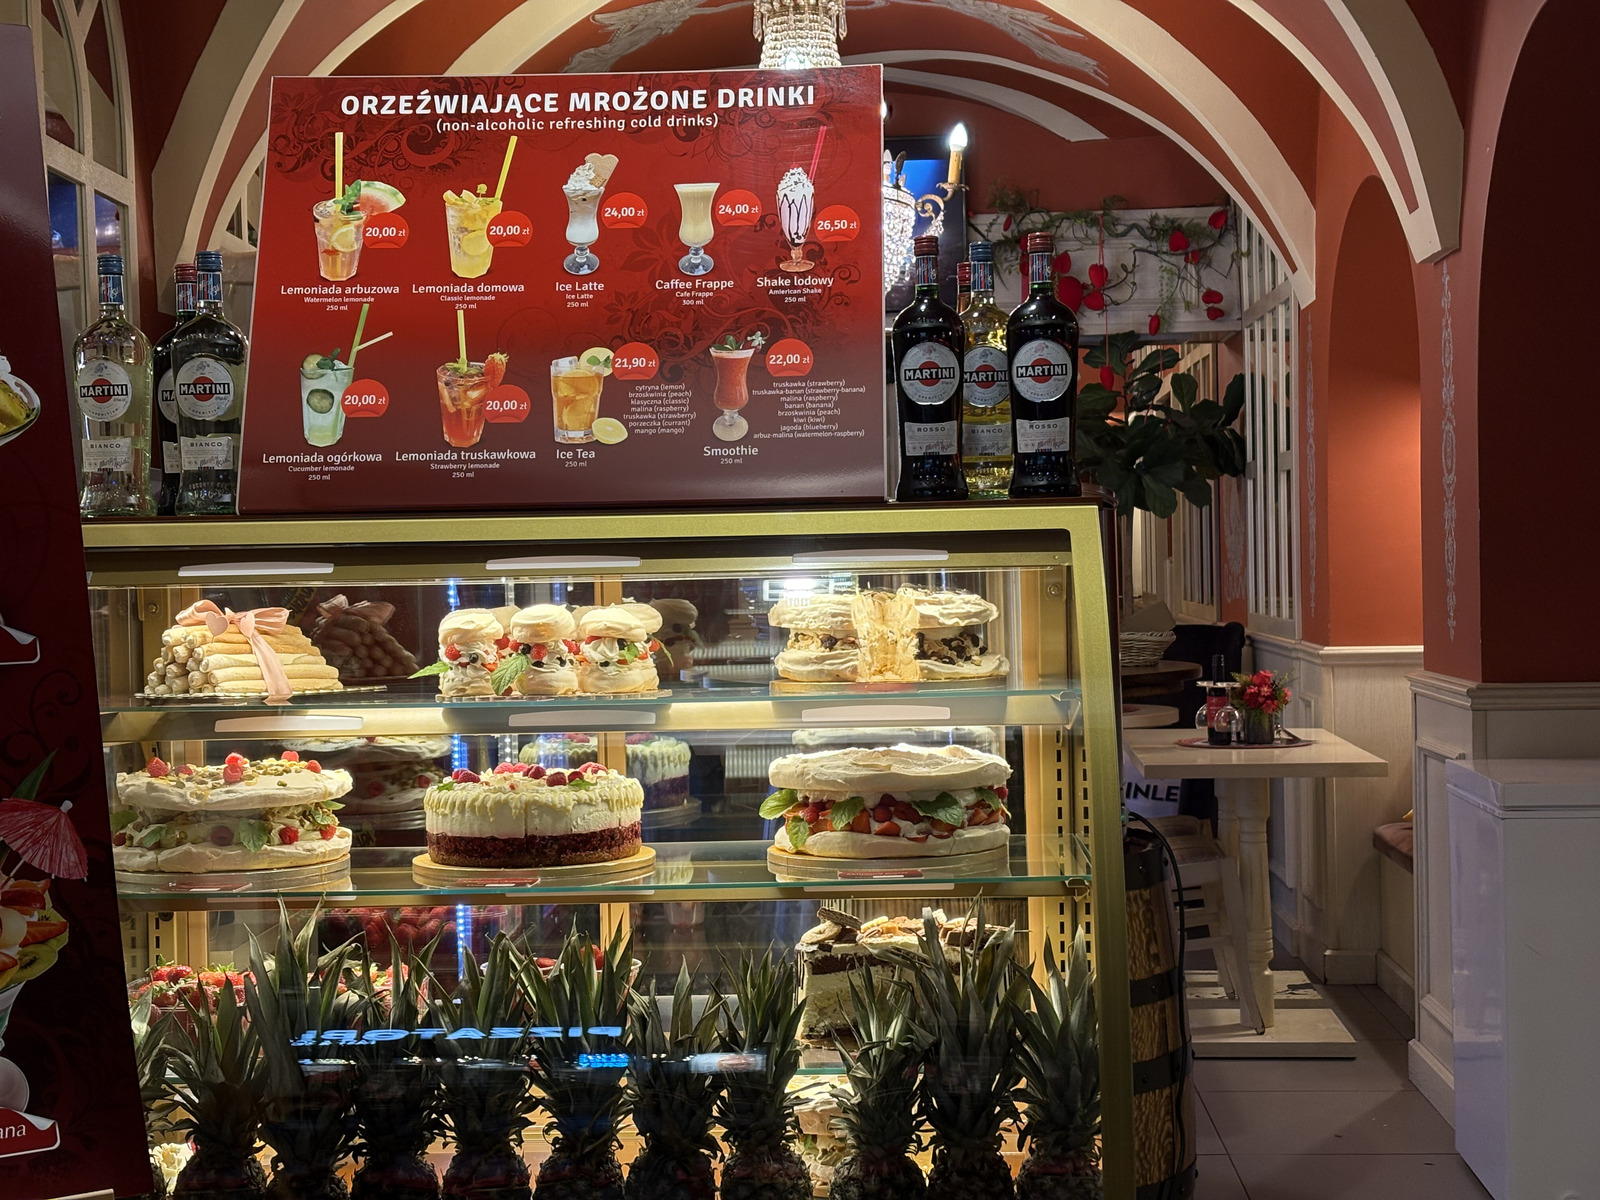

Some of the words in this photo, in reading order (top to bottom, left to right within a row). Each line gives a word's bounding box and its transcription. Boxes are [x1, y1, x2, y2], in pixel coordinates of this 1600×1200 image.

[341, 89, 558, 118] ORZEŹWIAJĄCE
[569, 86, 707, 112] MROŻONE
[718, 85, 814, 108] DRINKI
[436, 118, 544, 132] (non-alcoholic
[550, 114, 625, 130] refreshing
[630, 116, 662, 128] cold
[666, 113, 718, 128] drinks)
[604, 206, 635, 218] 24,00
[637, 207, 644, 217] zł
[718, 204, 749, 216] 24,00
[751, 204, 758, 214] zł
[818, 218, 848, 230] 26,50
[850, 220, 857, 230] zł
[365, 227, 396, 238] 20,00
[398, 228, 406, 238] zł
[489, 226, 520, 236] 20,00
[522, 226, 530, 236] zł
[556, 281, 572, 292] Ice
[576, 281, 604, 291] Latte
[656, 279, 692, 290] Caffee
[696, 278, 734, 290] Frappe
[756, 276, 790, 287] Shake
[794, 276, 834, 287] lodowy
[281, 285, 342, 295] Lemoniada
[345, 284, 400, 294] arbuzowa
[412, 283, 474, 294] Lemoniada
[477, 282, 524, 292] domowa
[614, 358, 646, 370] 21,90
[648, 359, 656, 368] zł
[769, 354, 800, 366] 22,00
[802, 355, 810, 364] zł
[905, 368, 954, 380] MARTINI
[1018, 365, 1066, 376] MARTINI
[964, 372, 1009, 382] MARTINI
[807, 379, 845, 387] (strawberry)
[81, 385, 126, 396] MARTINI
[180, 384, 229, 395] MARTINI
[806, 386, 866, 395] (strawberry-banana)
[344, 395, 376, 406] 20,00
[378, 396, 386, 405] zł
[804, 394, 838, 402] (raspberry)
[486, 400, 517, 412] 20,00
[519, 402, 527, 410] zł
[803, 423, 838, 431] (blueberry)
[794, 430, 864, 438] (watermelon-raspberry)
[396, 450, 458, 462] Lemoniada
[461, 449, 536, 460] truskawkowa
[556, 449, 574, 459] Ice
[577, 448, 596, 458] Tea
[703, 444, 759, 456] Smoothie
[262, 453, 324, 464] Lemoniada
[327, 452, 382, 465] ogórkowa
[430, 463, 467, 471] Strawberry
[1124, 782, 1180, 802] INLE
